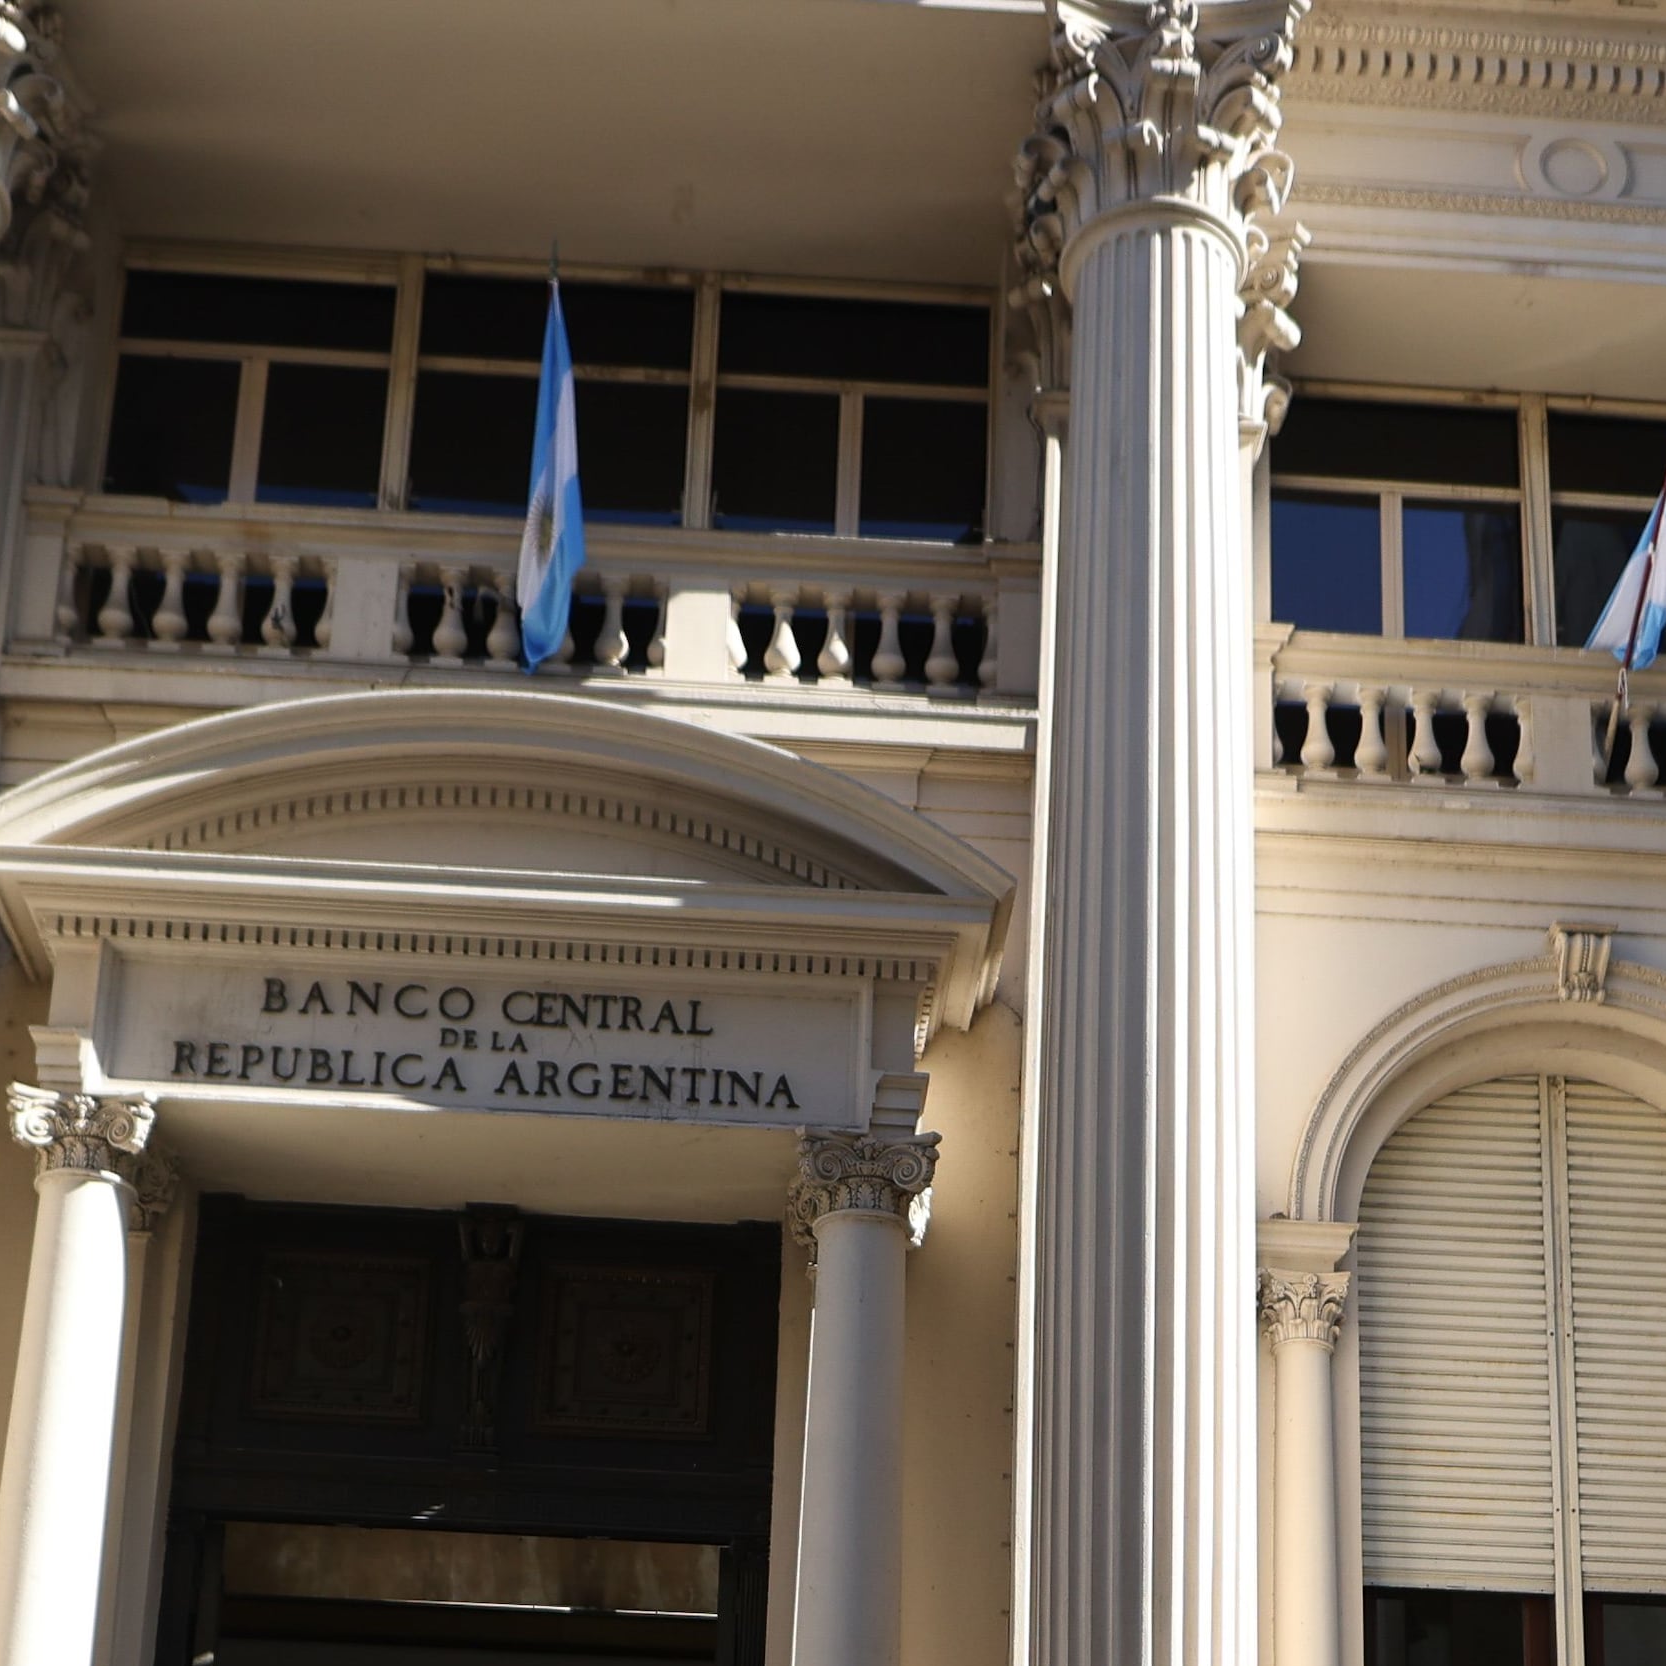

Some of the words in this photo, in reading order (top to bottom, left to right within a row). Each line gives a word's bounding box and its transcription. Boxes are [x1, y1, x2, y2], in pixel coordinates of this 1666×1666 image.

[261, 977, 476, 1021] BANCO
[502, 990, 715, 1037] CENTRAL
[439, 1027, 479, 1050] DE
[491, 1031, 528, 1054] LA
[171, 1040, 467, 1092] REPUBLICA
[494, 1060, 801, 1109] ARGENTINA
